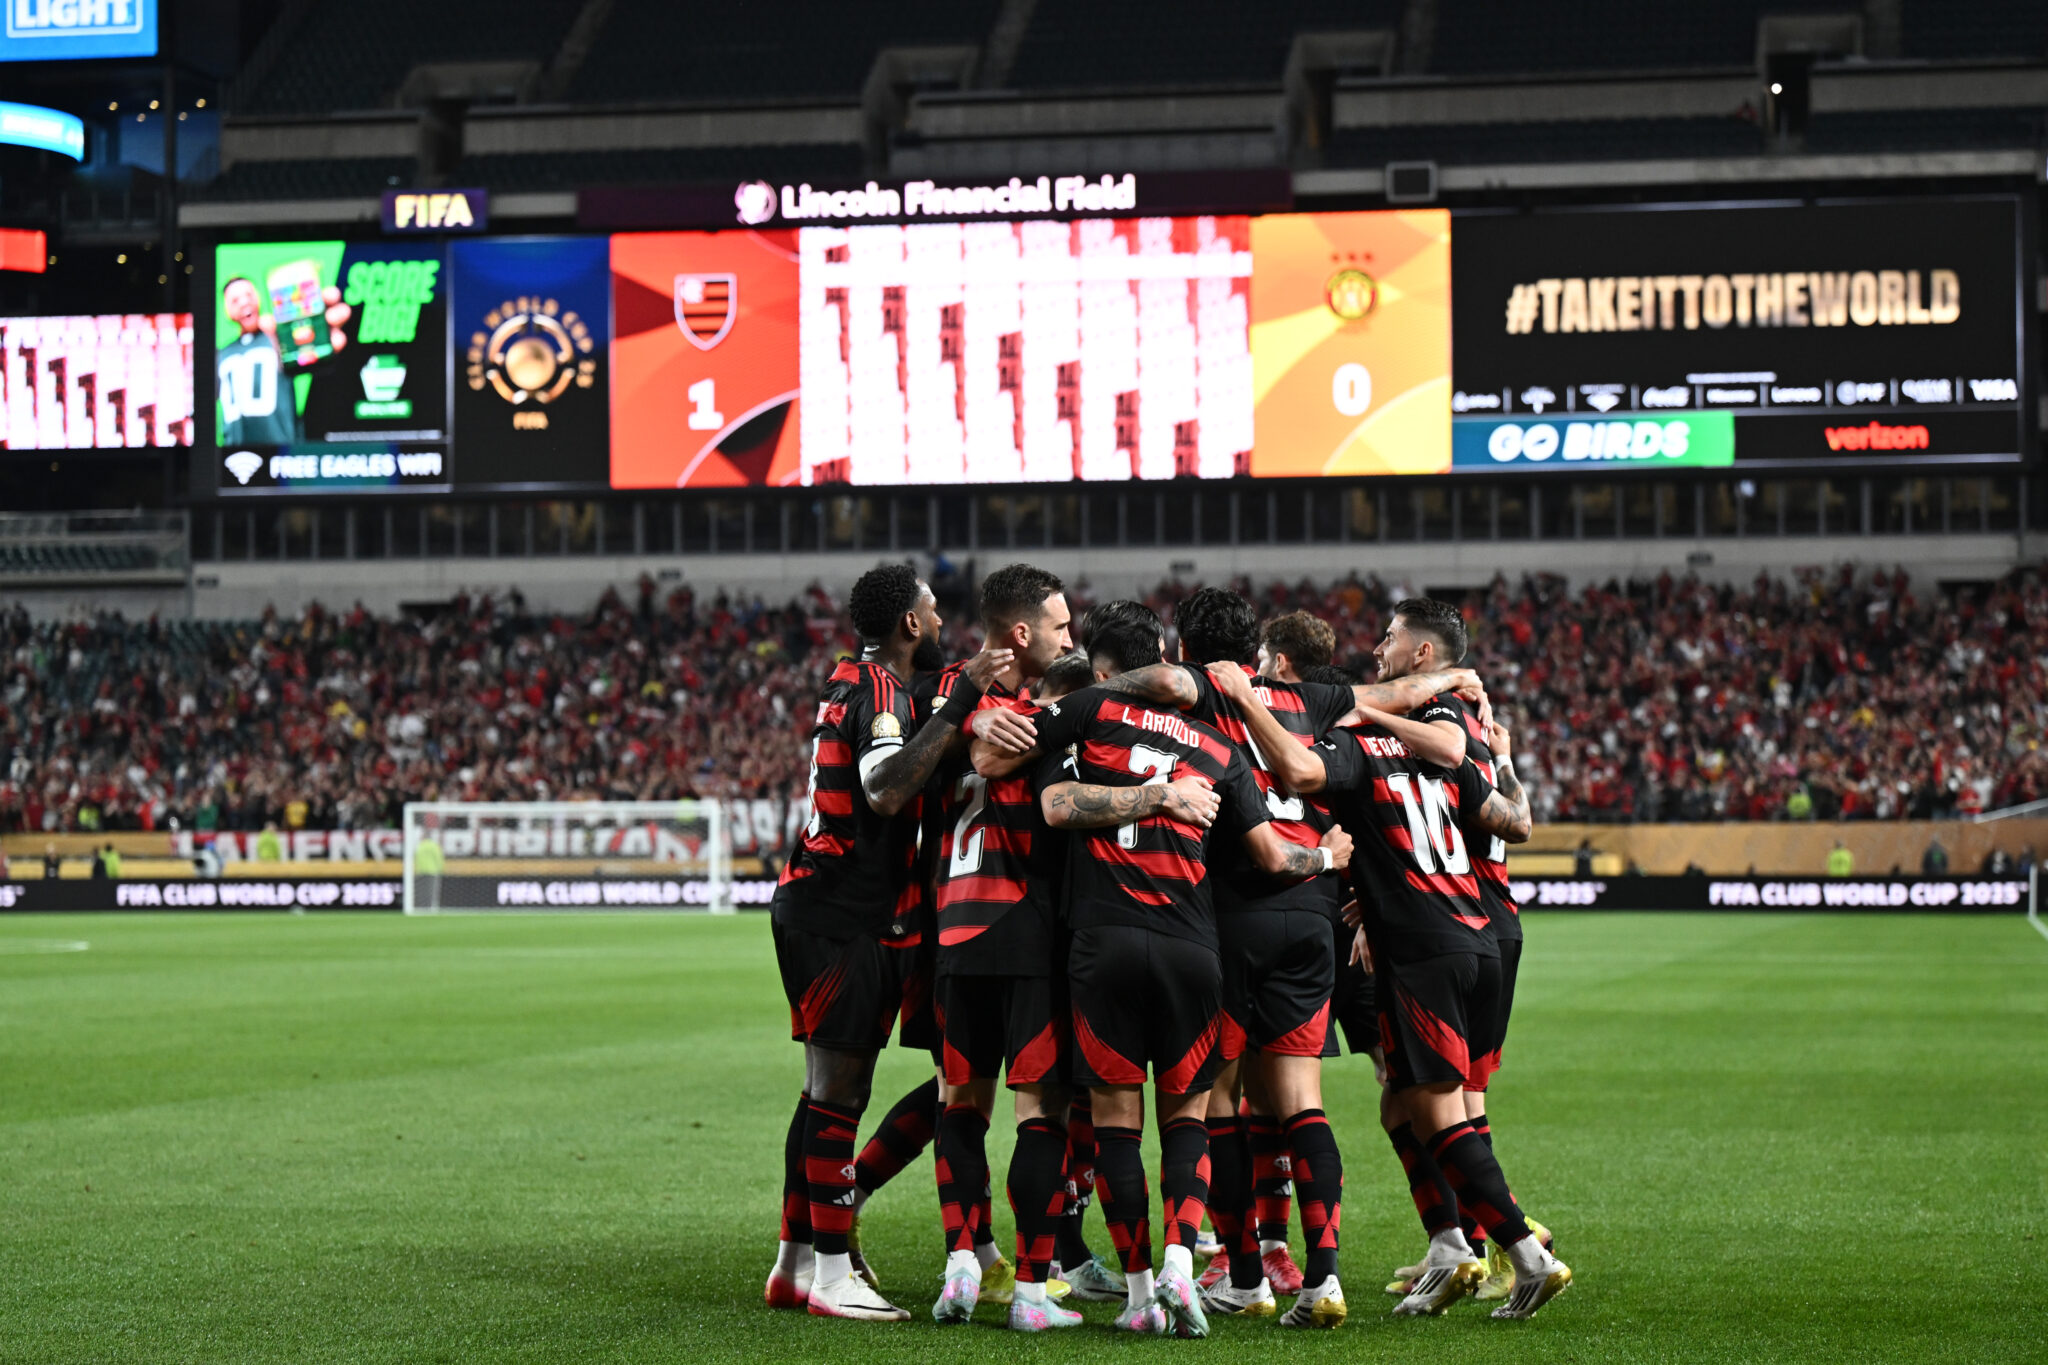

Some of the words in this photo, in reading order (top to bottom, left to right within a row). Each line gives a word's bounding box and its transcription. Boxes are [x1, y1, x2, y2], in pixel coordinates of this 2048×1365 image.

[14, 0, 130, 28] LIGHT
[395, 193, 473, 228] FIFA
[781, 181, 900, 218] Lincoln
[904, 176, 1052, 215] Financial
[1055, 173, 1136, 211] Field
[344, 260, 440, 306] SCORE
[1506, 269, 1961, 335] #TAKEITTOTHEWORLD
[688, 378, 724, 430] 1
[1332, 363, 1372, 417] 0
[1488, 423, 1559, 462] GO
[1562, 421, 1690, 460] BIRDS
[1824, 420, 1930, 450] verizon
[269, 455, 319, 478] FREE
[320, 453, 396, 477] EAGLES
[397, 453, 442, 476] WIFI
[1117, 743, 1180, 849] 7
[949, 770, 988, 878] 2
[1387, 772, 1470, 875] 10
[117, 884, 162, 906] FIFA
[163, 883, 218, 906] CLUB
[219, 882, 295, 905] WORLD
[296, 882, 341, 905] CUP
[498, 882, 544, 905] FIFA
[545, 882, 600, 905] CLUB
[601, 881, 682, 904] WORLD
[1709, 883, 1760, 905] FIFA
[1761, 882, 1821, 905] CLUB
[1822, 882, 1909, 905] WORLD
[1909, 882, 1958, 905] CUP
